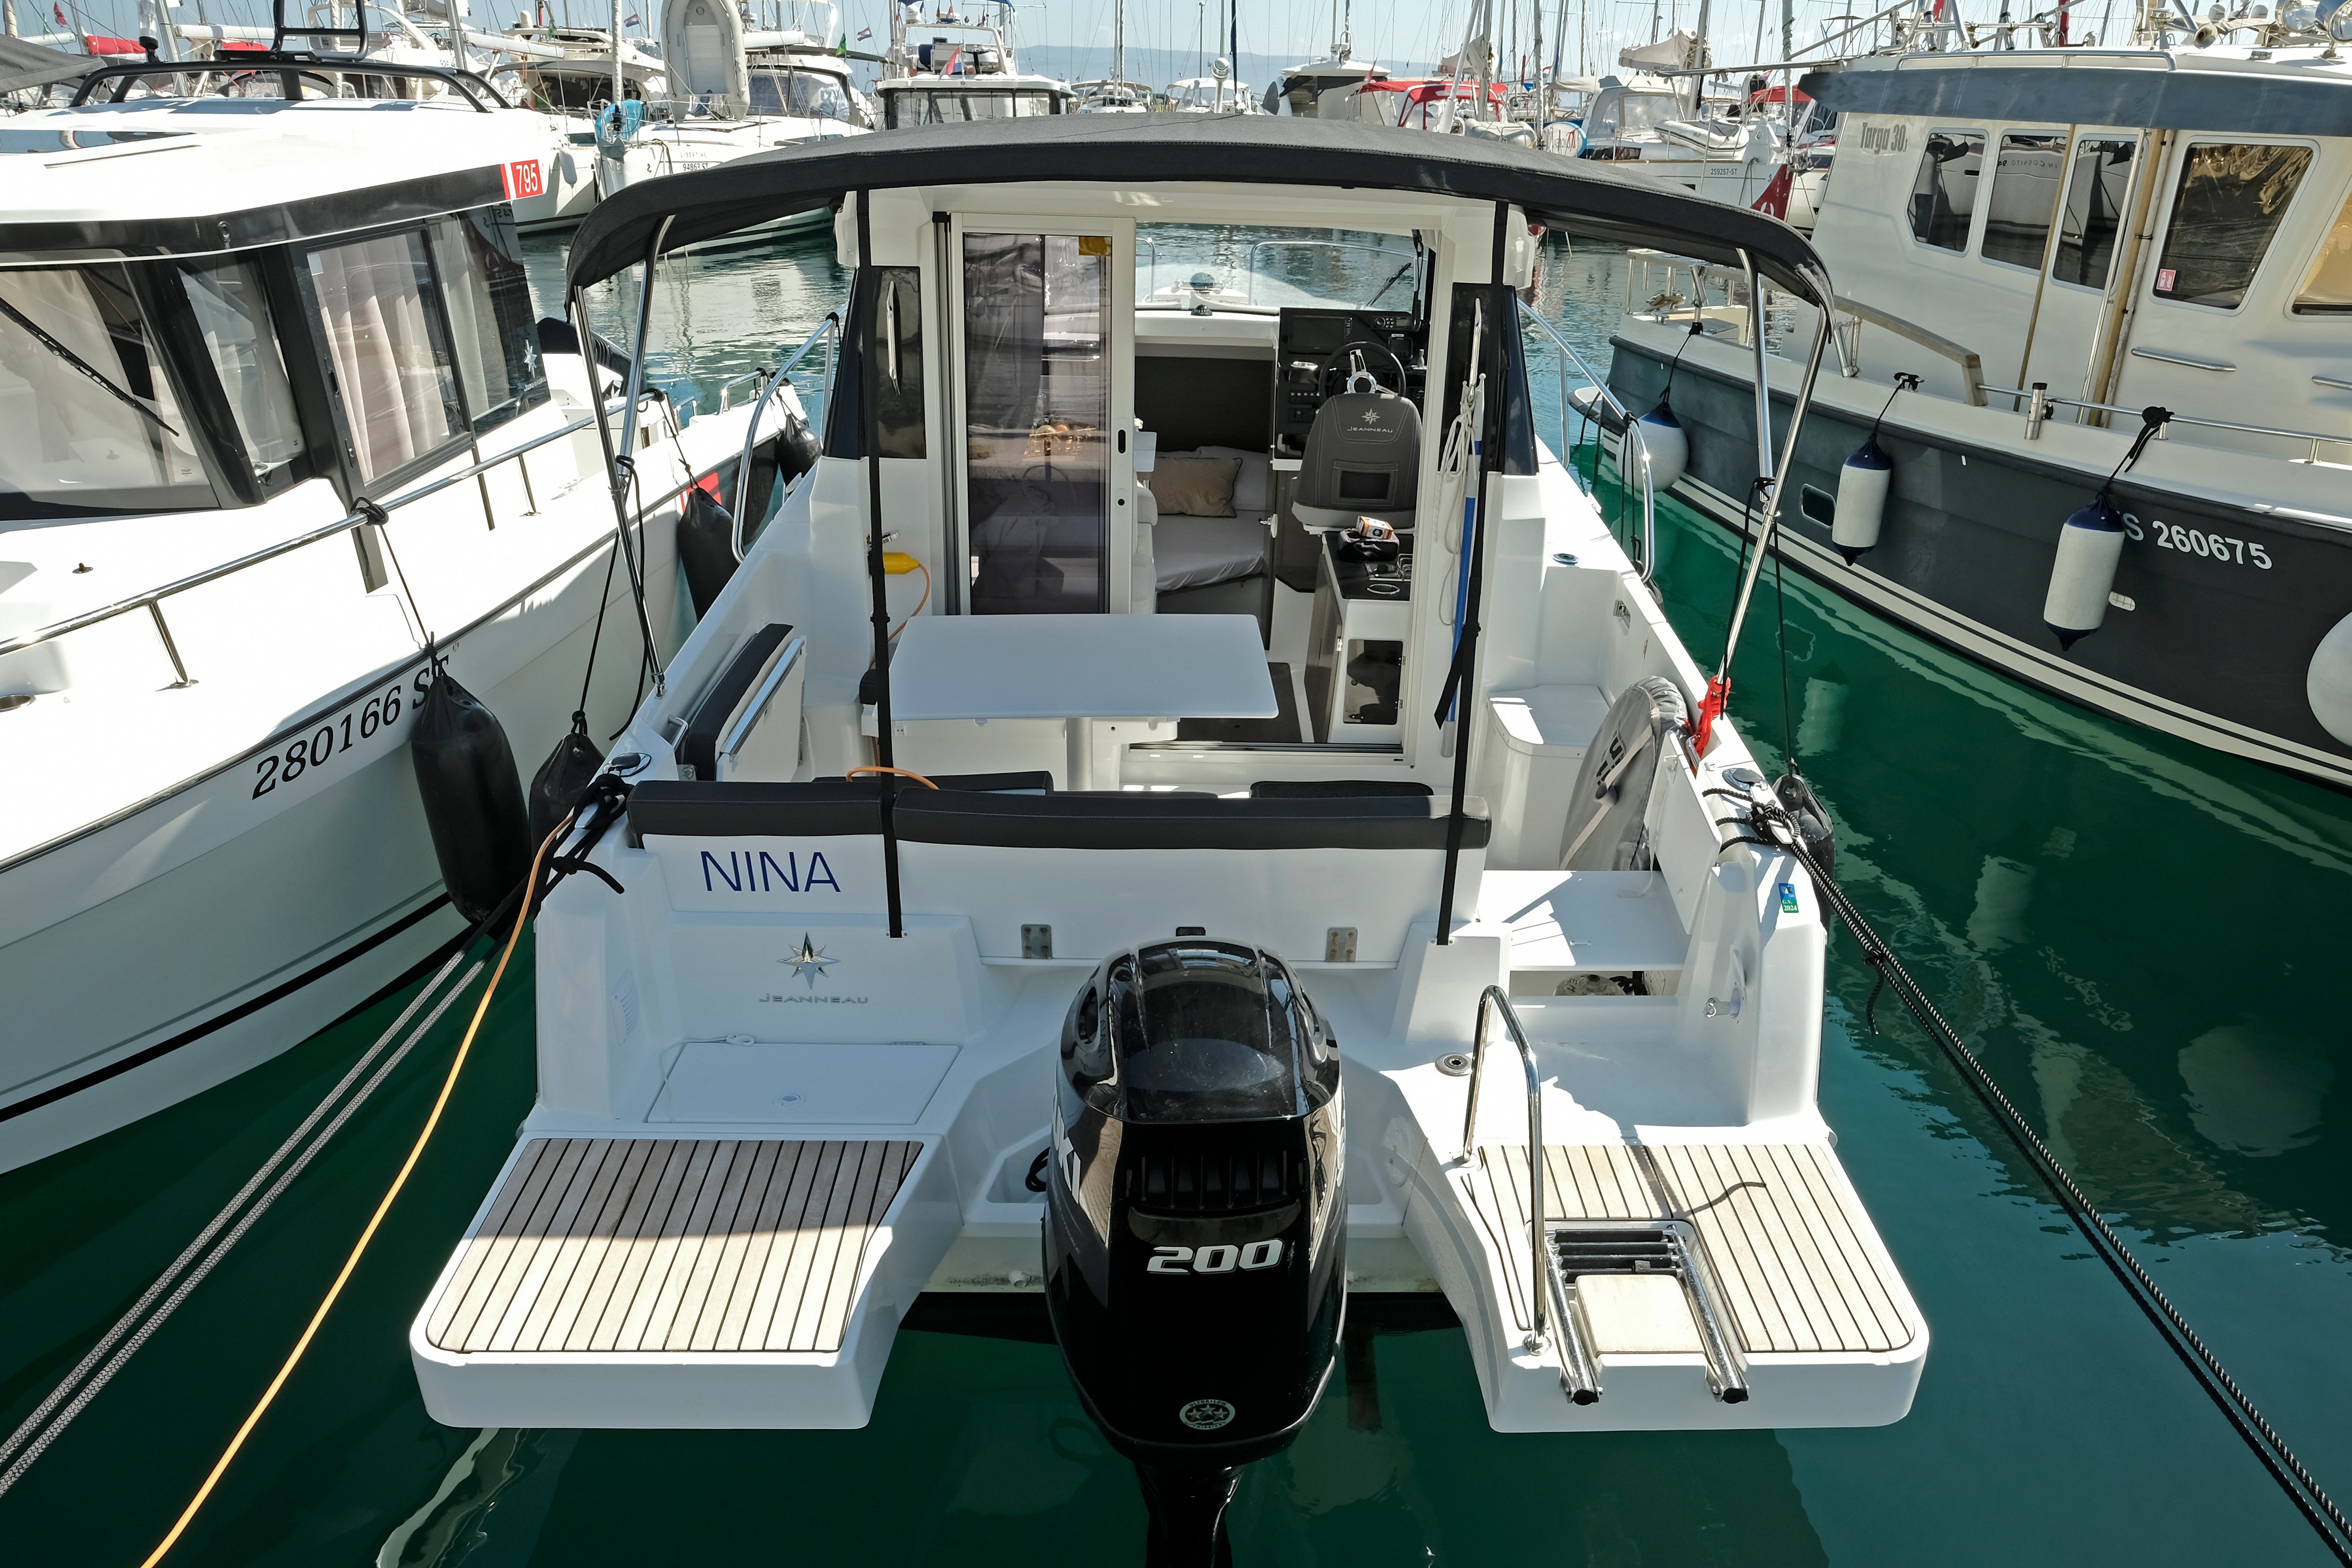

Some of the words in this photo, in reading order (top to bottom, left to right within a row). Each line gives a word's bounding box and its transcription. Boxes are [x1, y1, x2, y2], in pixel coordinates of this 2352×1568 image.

[1860, 122, 1890, 155] Targa
[516, 163, 538, 194] 795
[2116, 511, 2144, 541] S
[2152, 520, 2272, 569] 260675
[252, 685, 401, 800] 280166
[700, 851, 841, 892] NINA
[759, 993, 868, 1004] JEANNEAU
[1147, 1238, 1284, 1274] 200
